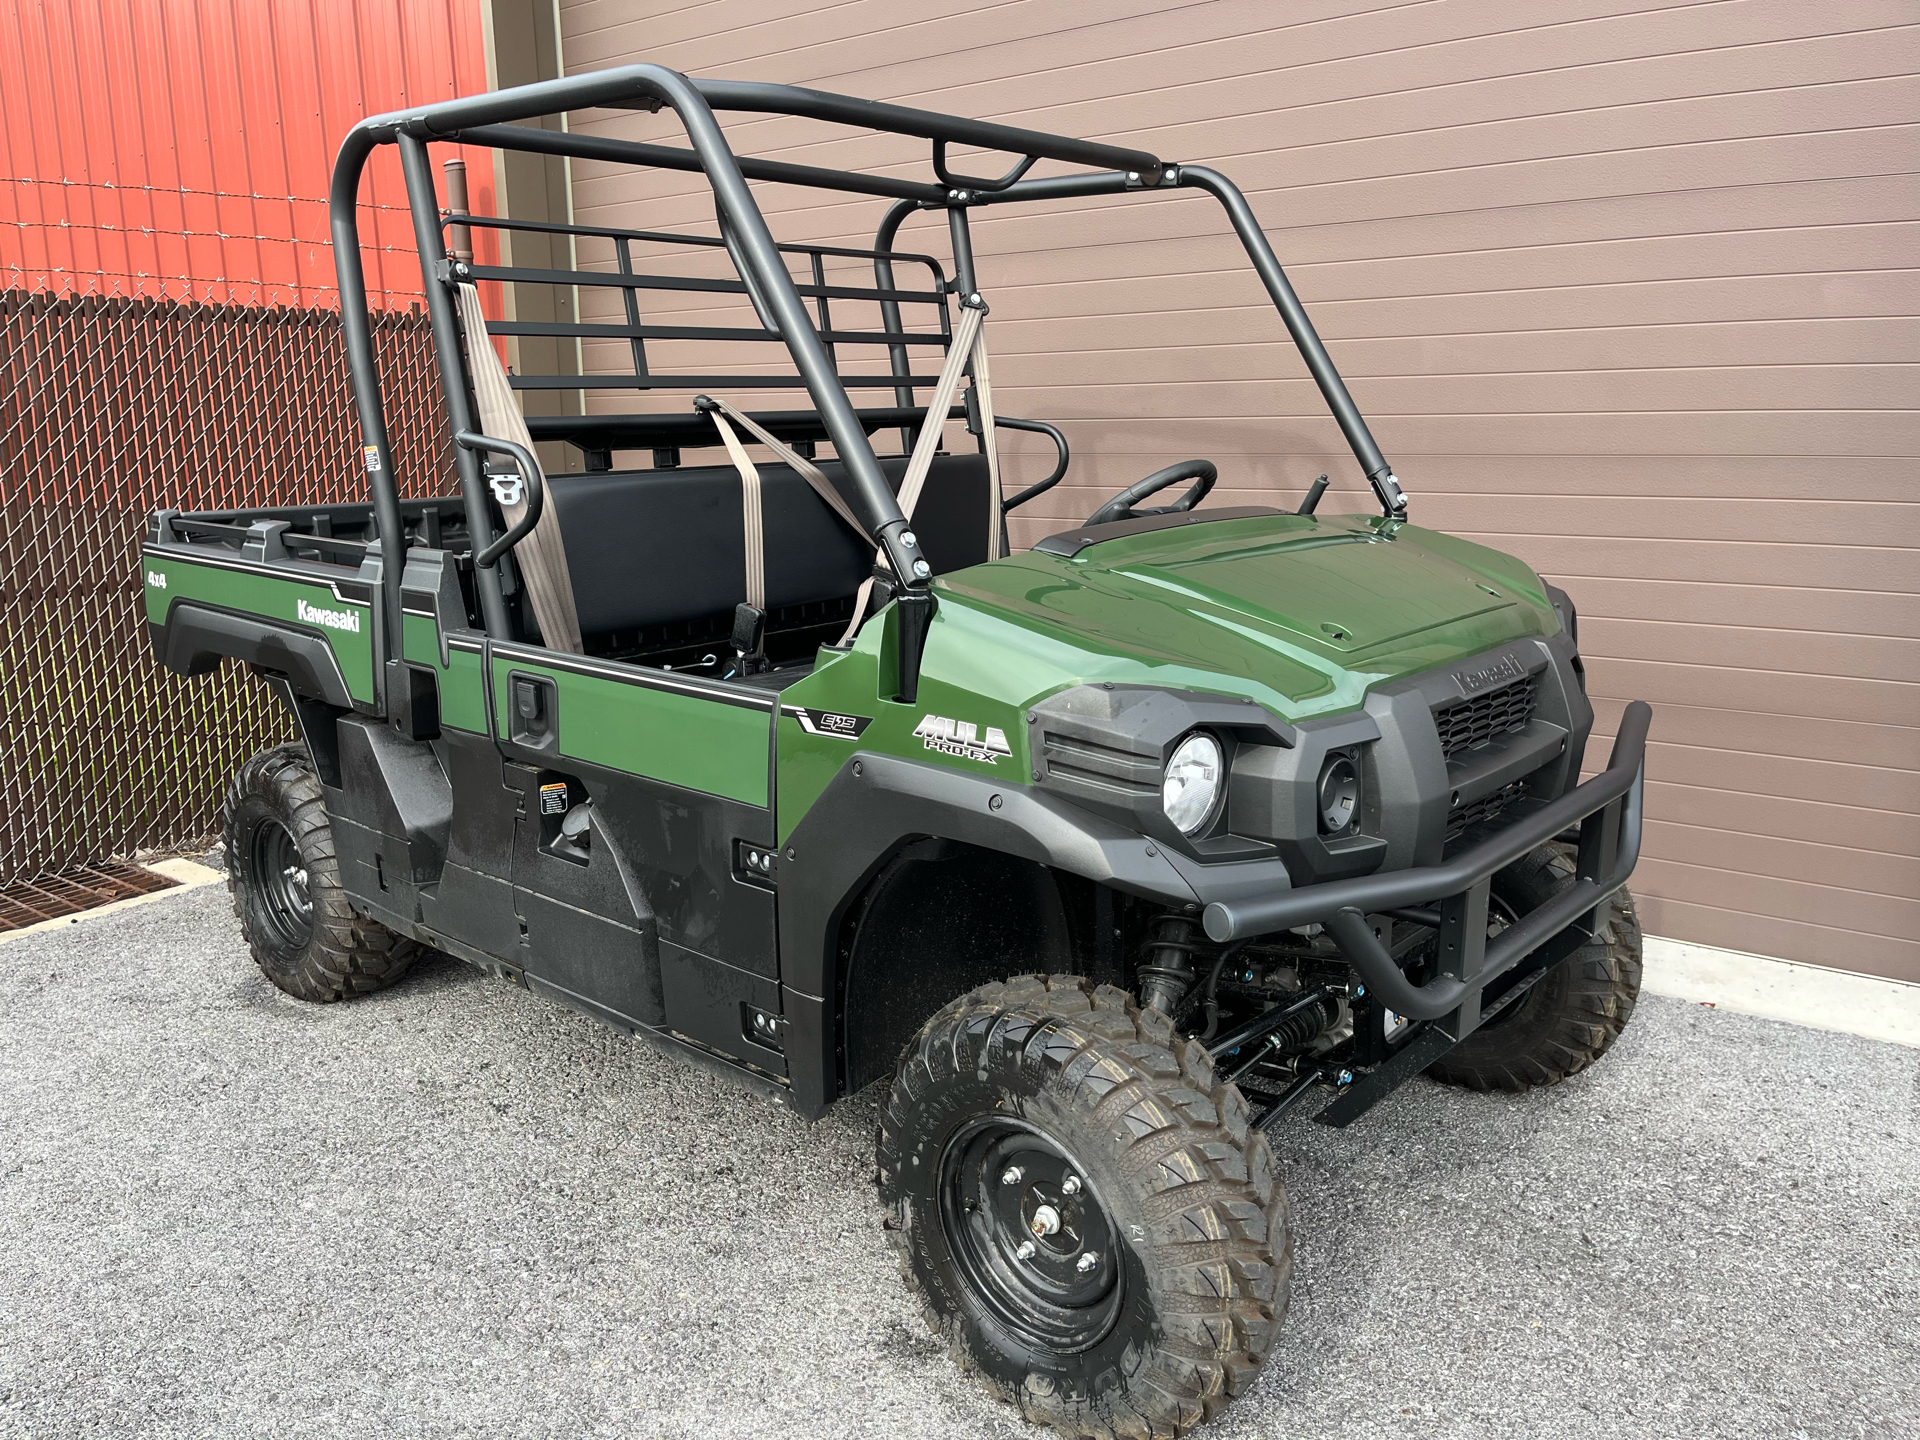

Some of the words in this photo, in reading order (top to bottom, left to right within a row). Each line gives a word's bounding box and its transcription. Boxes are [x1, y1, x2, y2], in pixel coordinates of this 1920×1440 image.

[147, 571, 167, 589] 4x4
[297, 599, 360, 633] Kawasaki
[1450, 653, 1525, 695] Kawasaki
[820, 713, 857, 729] EPS
[912, 714, 1013, 757] MULE
